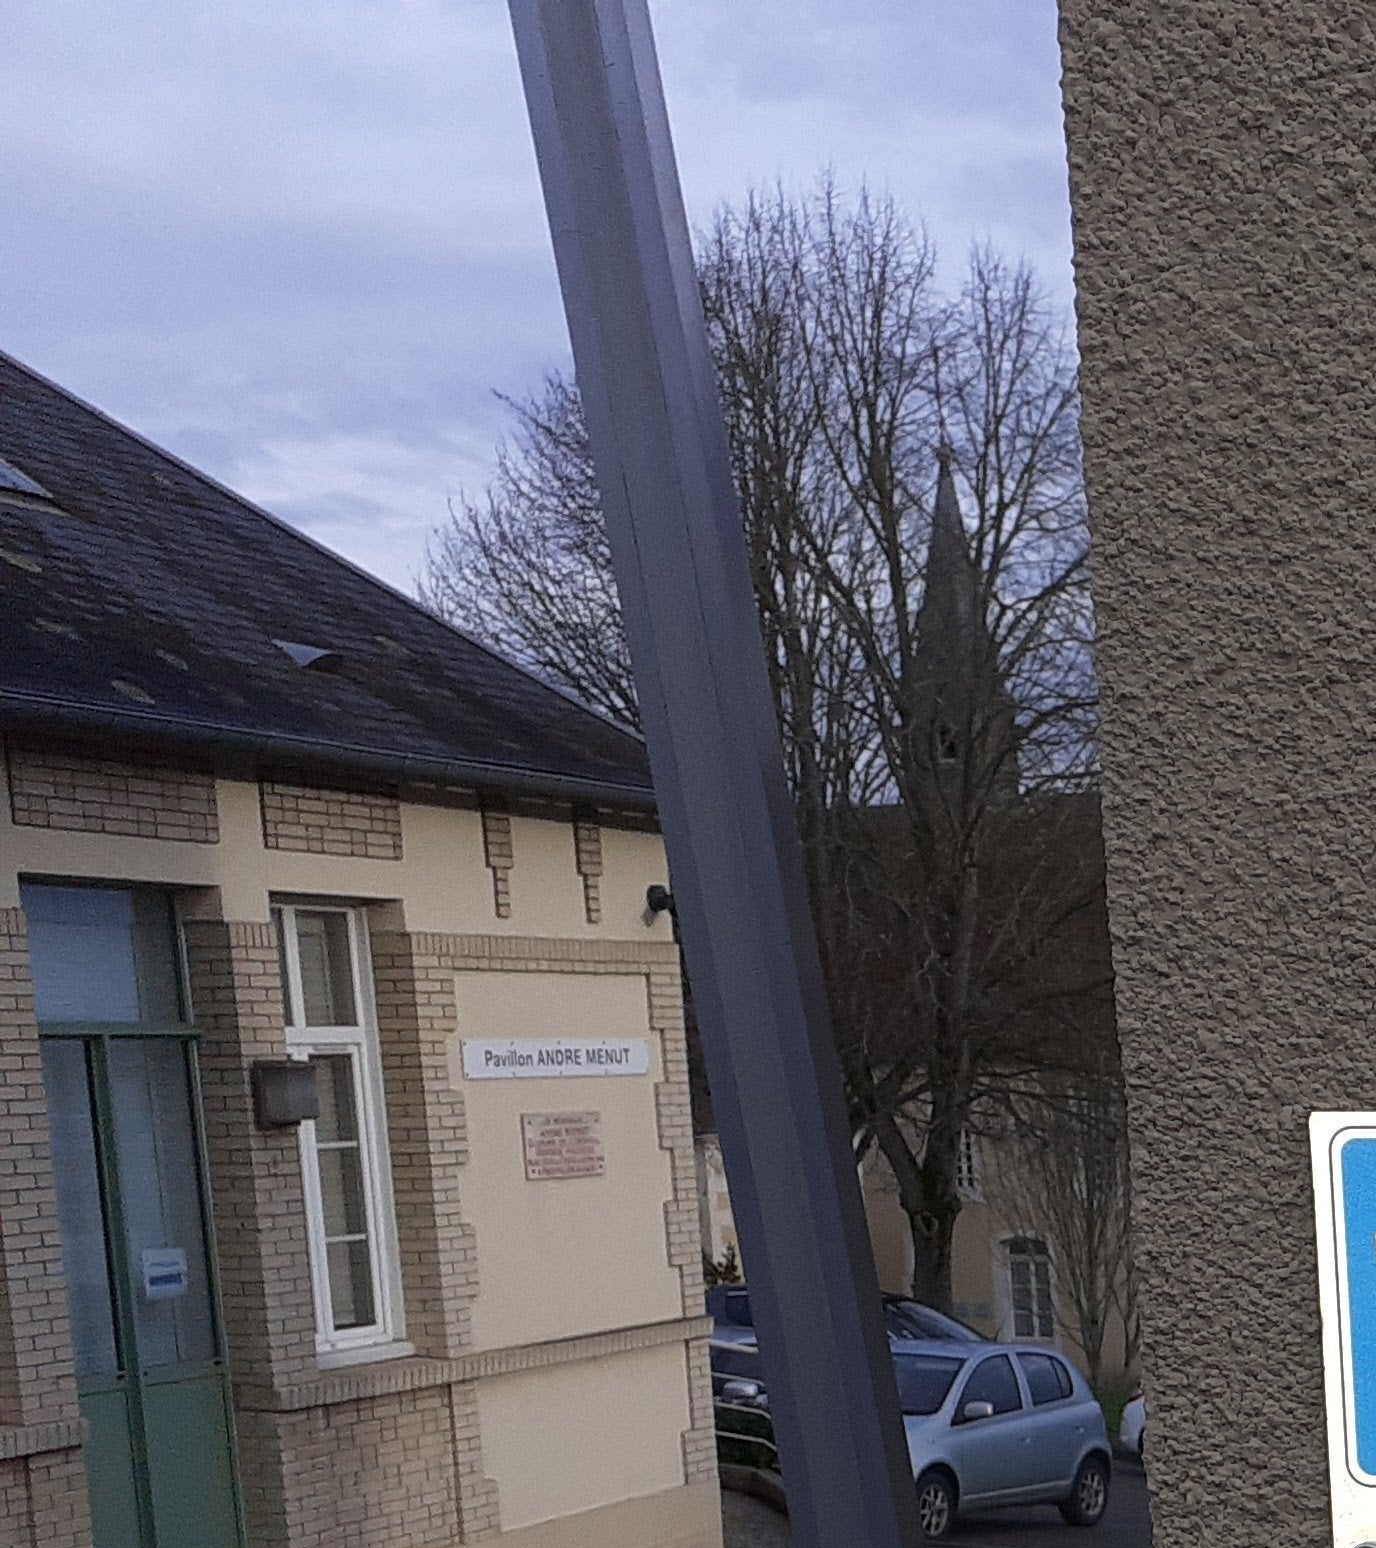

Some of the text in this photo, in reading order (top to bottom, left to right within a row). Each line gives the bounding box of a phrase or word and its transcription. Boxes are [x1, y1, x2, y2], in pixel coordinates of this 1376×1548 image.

[484, 1048, 630, 1067] Pavillon ANDRE MENUT
